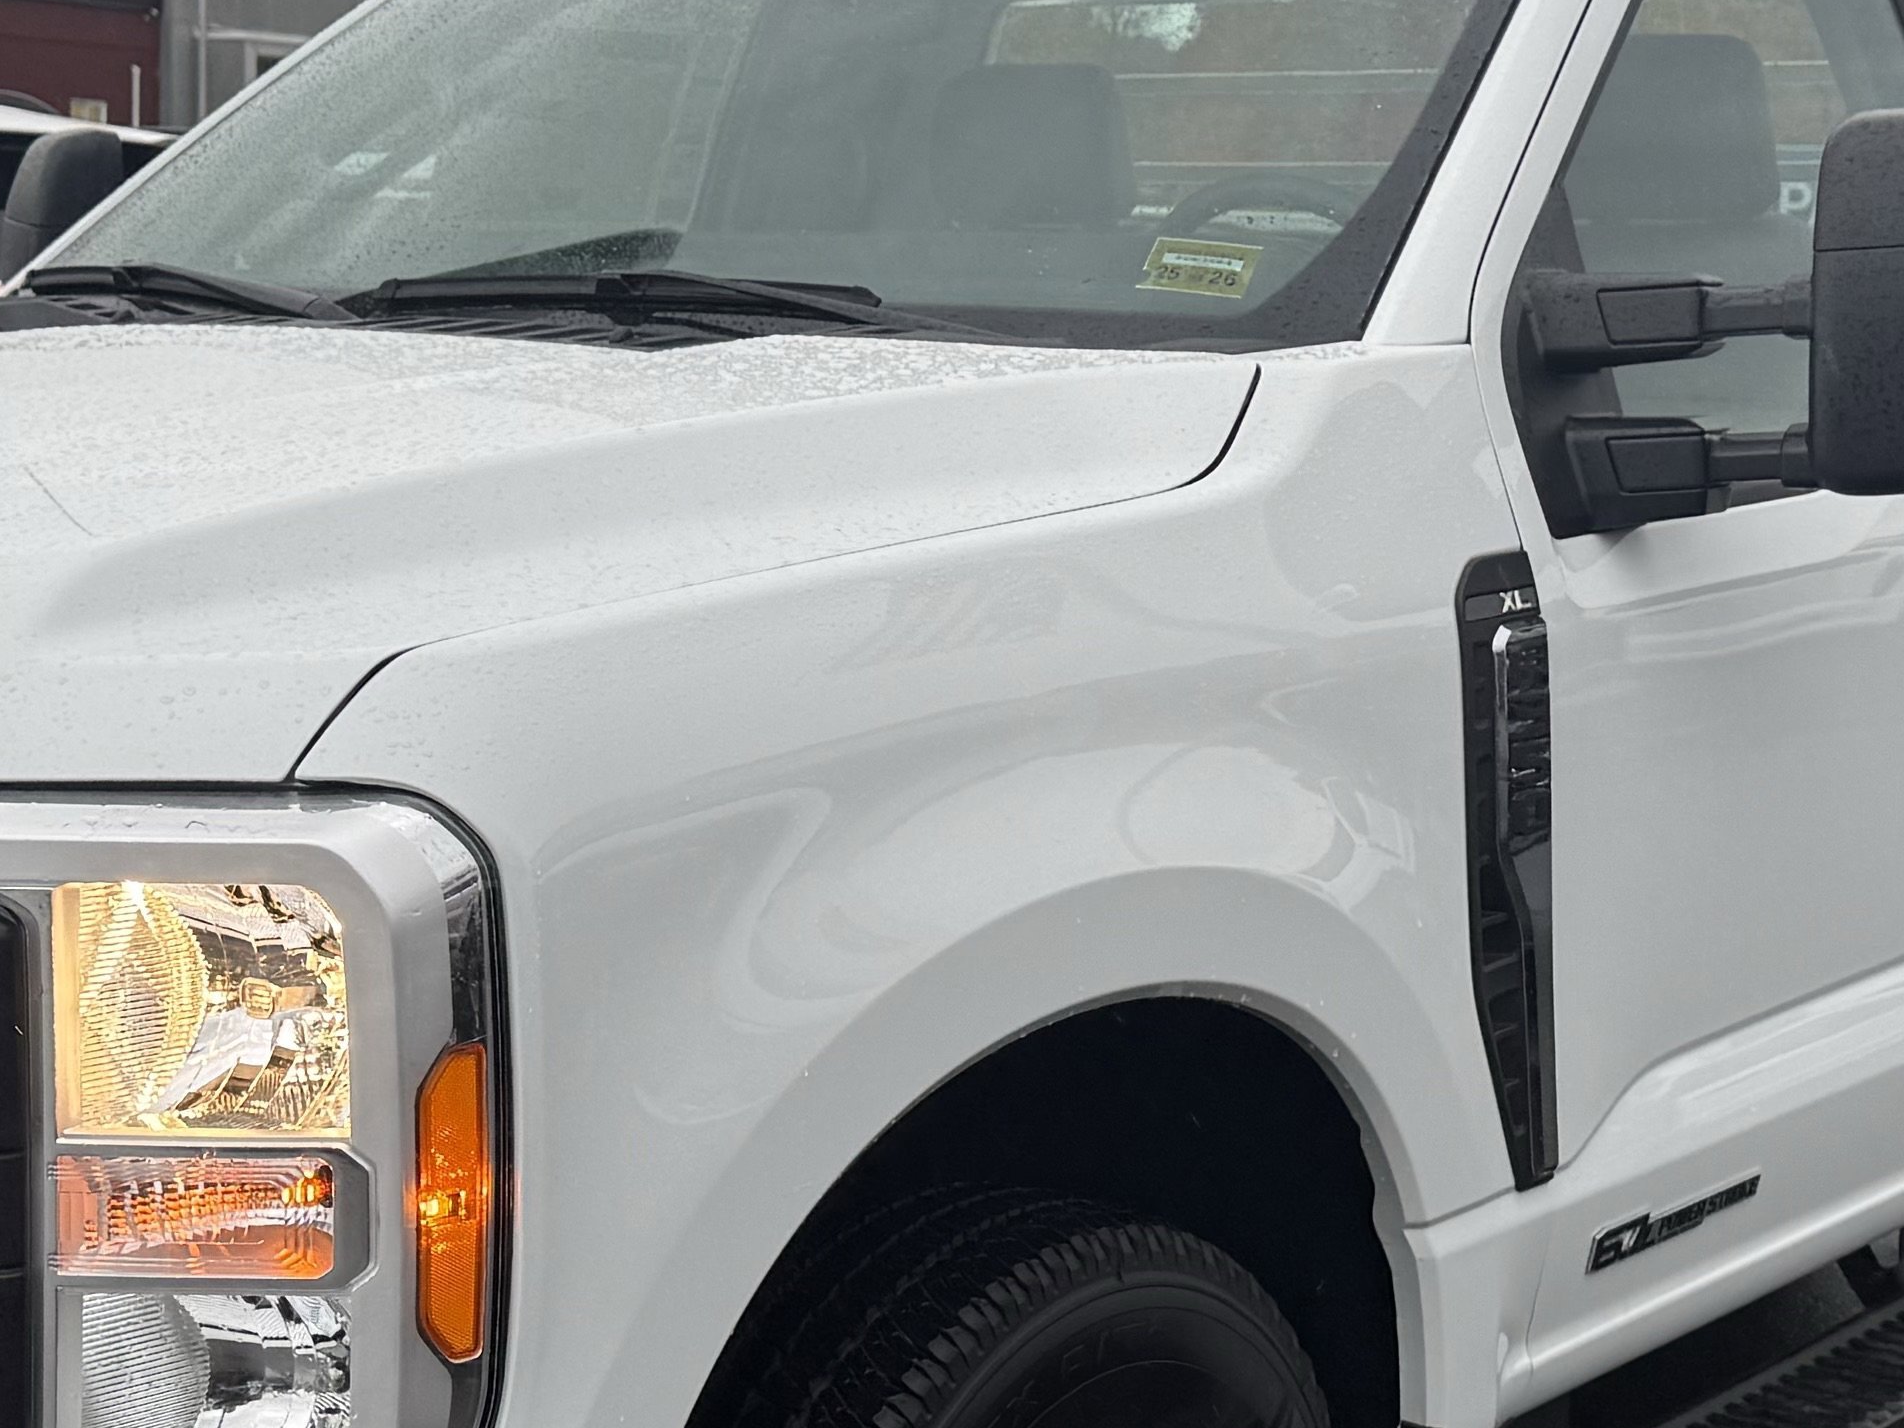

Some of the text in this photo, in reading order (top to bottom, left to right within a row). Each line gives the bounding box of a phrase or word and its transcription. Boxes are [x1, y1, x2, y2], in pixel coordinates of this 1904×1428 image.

[1780, 181, 1812, 214] P
[1156, 265, 1181, 281] 25
[1208, 271, 1238, 287] 26
[1499, 589, 1532, 613] XL
